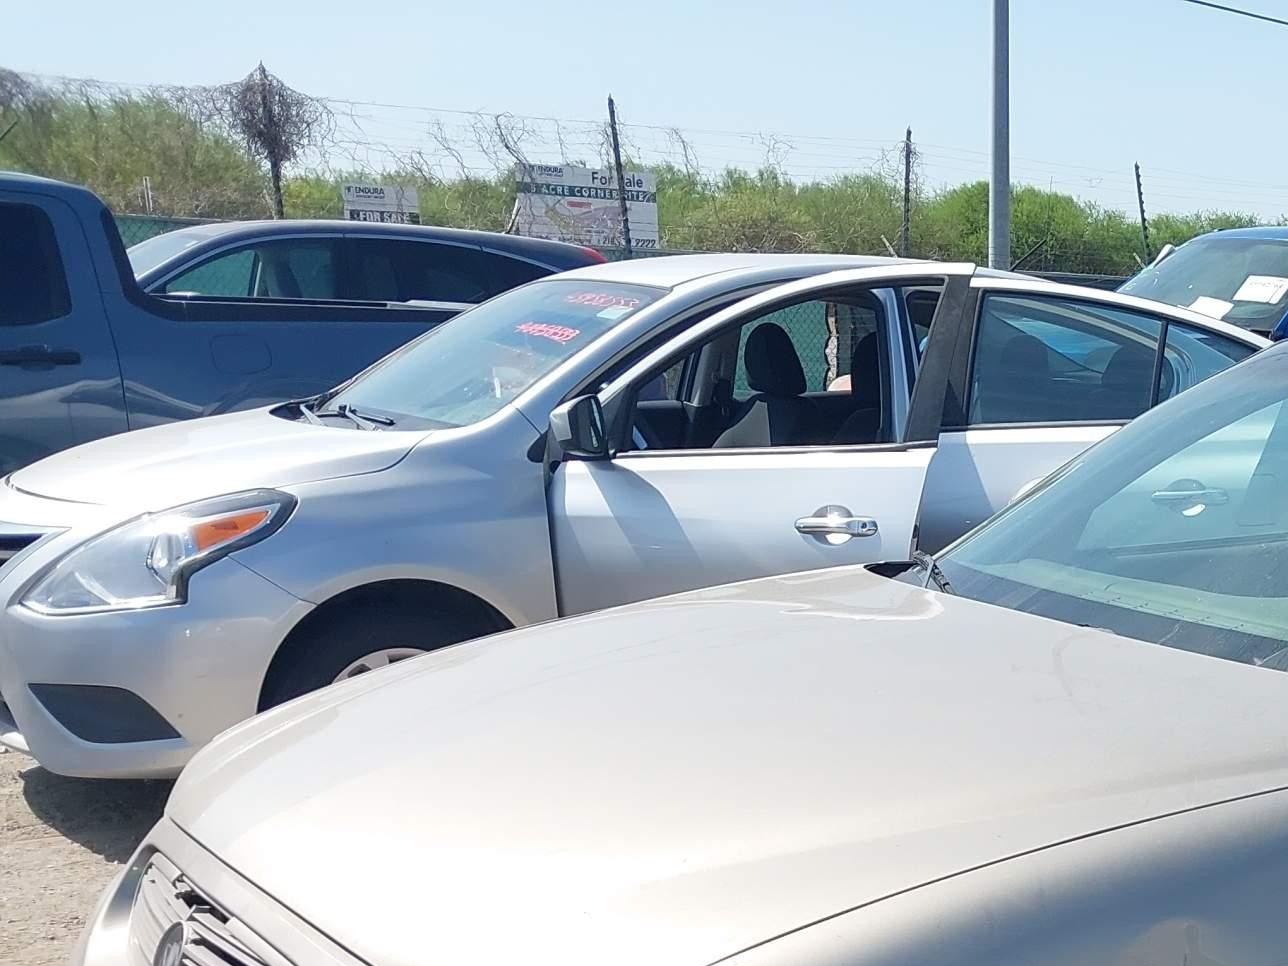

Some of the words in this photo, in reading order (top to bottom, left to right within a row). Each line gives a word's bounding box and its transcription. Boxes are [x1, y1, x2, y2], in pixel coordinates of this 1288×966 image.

[591, 171, 613, 186] For
[354, 186, 385, 195] ENDURA
[542, 184, 570, 195] ACRE
[574, 187, 620, 200] CORNER
[359, 211, 381, 223] FOR
